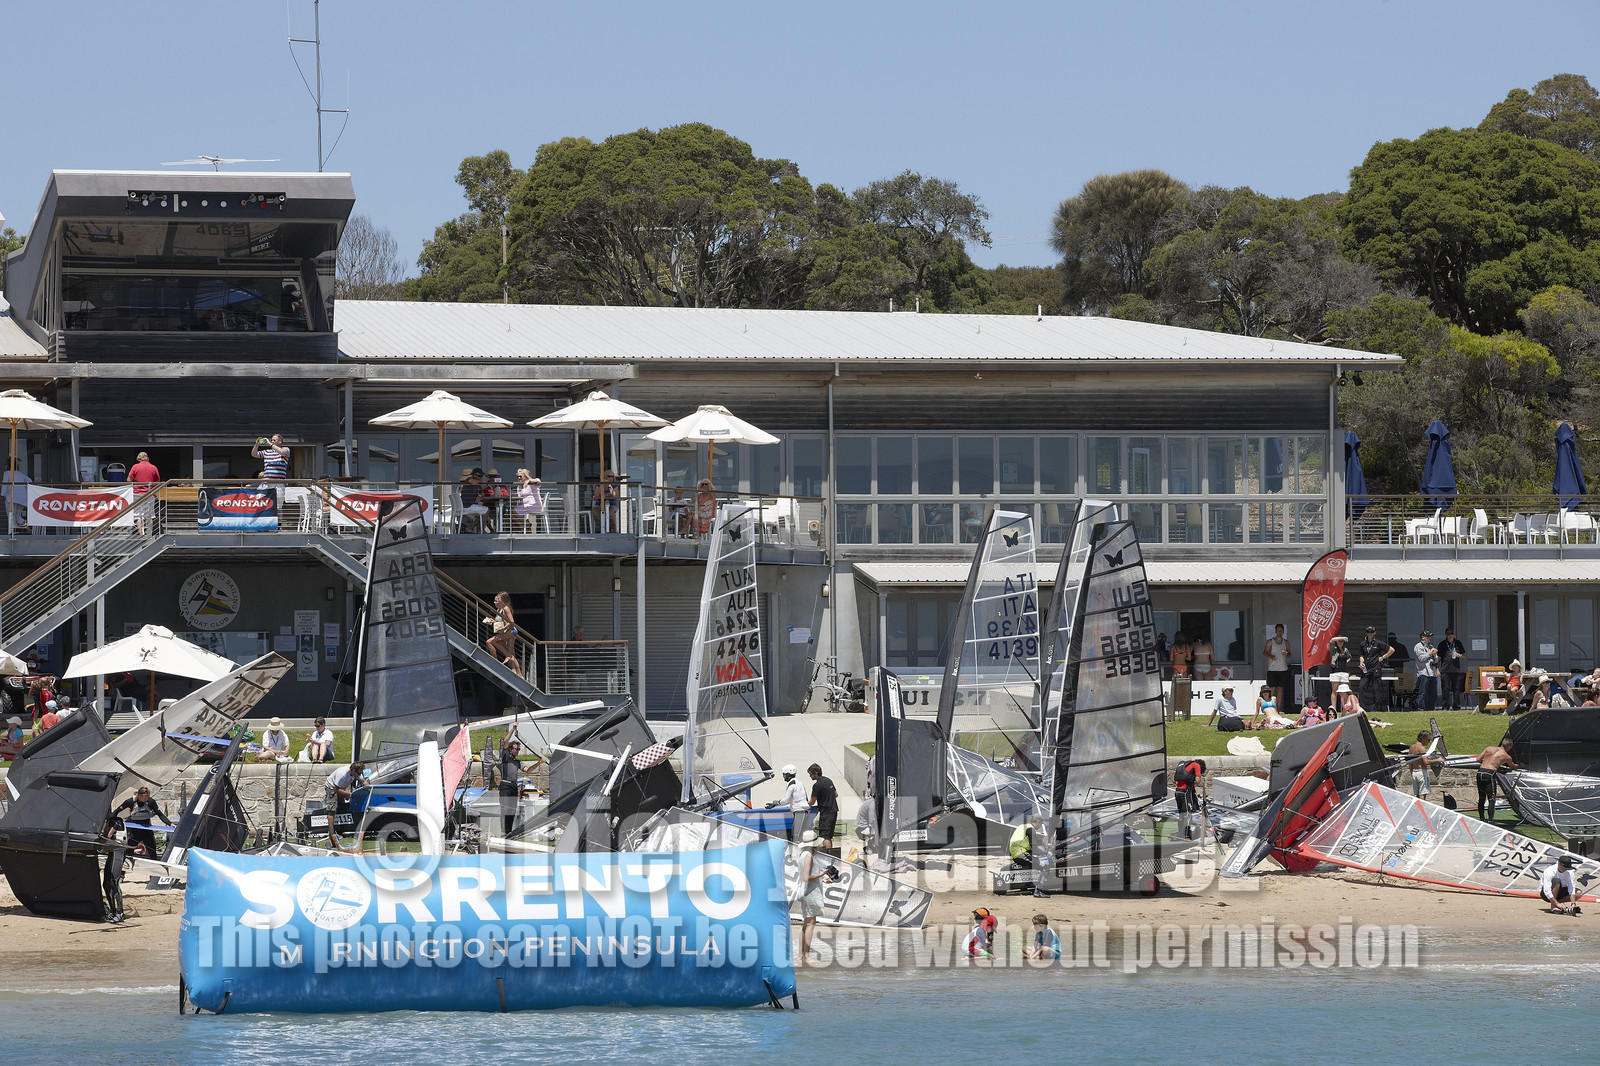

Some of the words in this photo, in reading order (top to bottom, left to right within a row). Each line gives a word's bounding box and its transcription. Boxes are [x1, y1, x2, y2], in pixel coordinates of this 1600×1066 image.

[38, 499, 123, 511] RONSTAN
[216, 497, 269, 507] RONSTAN
[187, 571, 226, 587] SORRENTO
[225, 580, 238, 610] SAILING
[390, 576, 434, 598] FRA
[727, 589, 755, 612] AUT
[1003, 594, 1037, 617] ITA
[189, 615, 208, 627] BOAT
[210, 616, 230, 628] CLUB
[385, 616, 442, 639] 4065
[1117, 604, 1150, 630] SUI
[717, 632, 759, 659] 4246
[989, 637, 1037, 660] 4139
[1104, 651, 1156, 679] 3836
[1500, 842, 1538, 879] 4215
[1058, 868, 1078, 878] SLAM
[315, 911, 334, 923] BOAT
[337, 908, 358, 922] CLUB
[280, 938, 508, 965] MRNINGTON
[525, 935, 722, 957] PENINSULA
